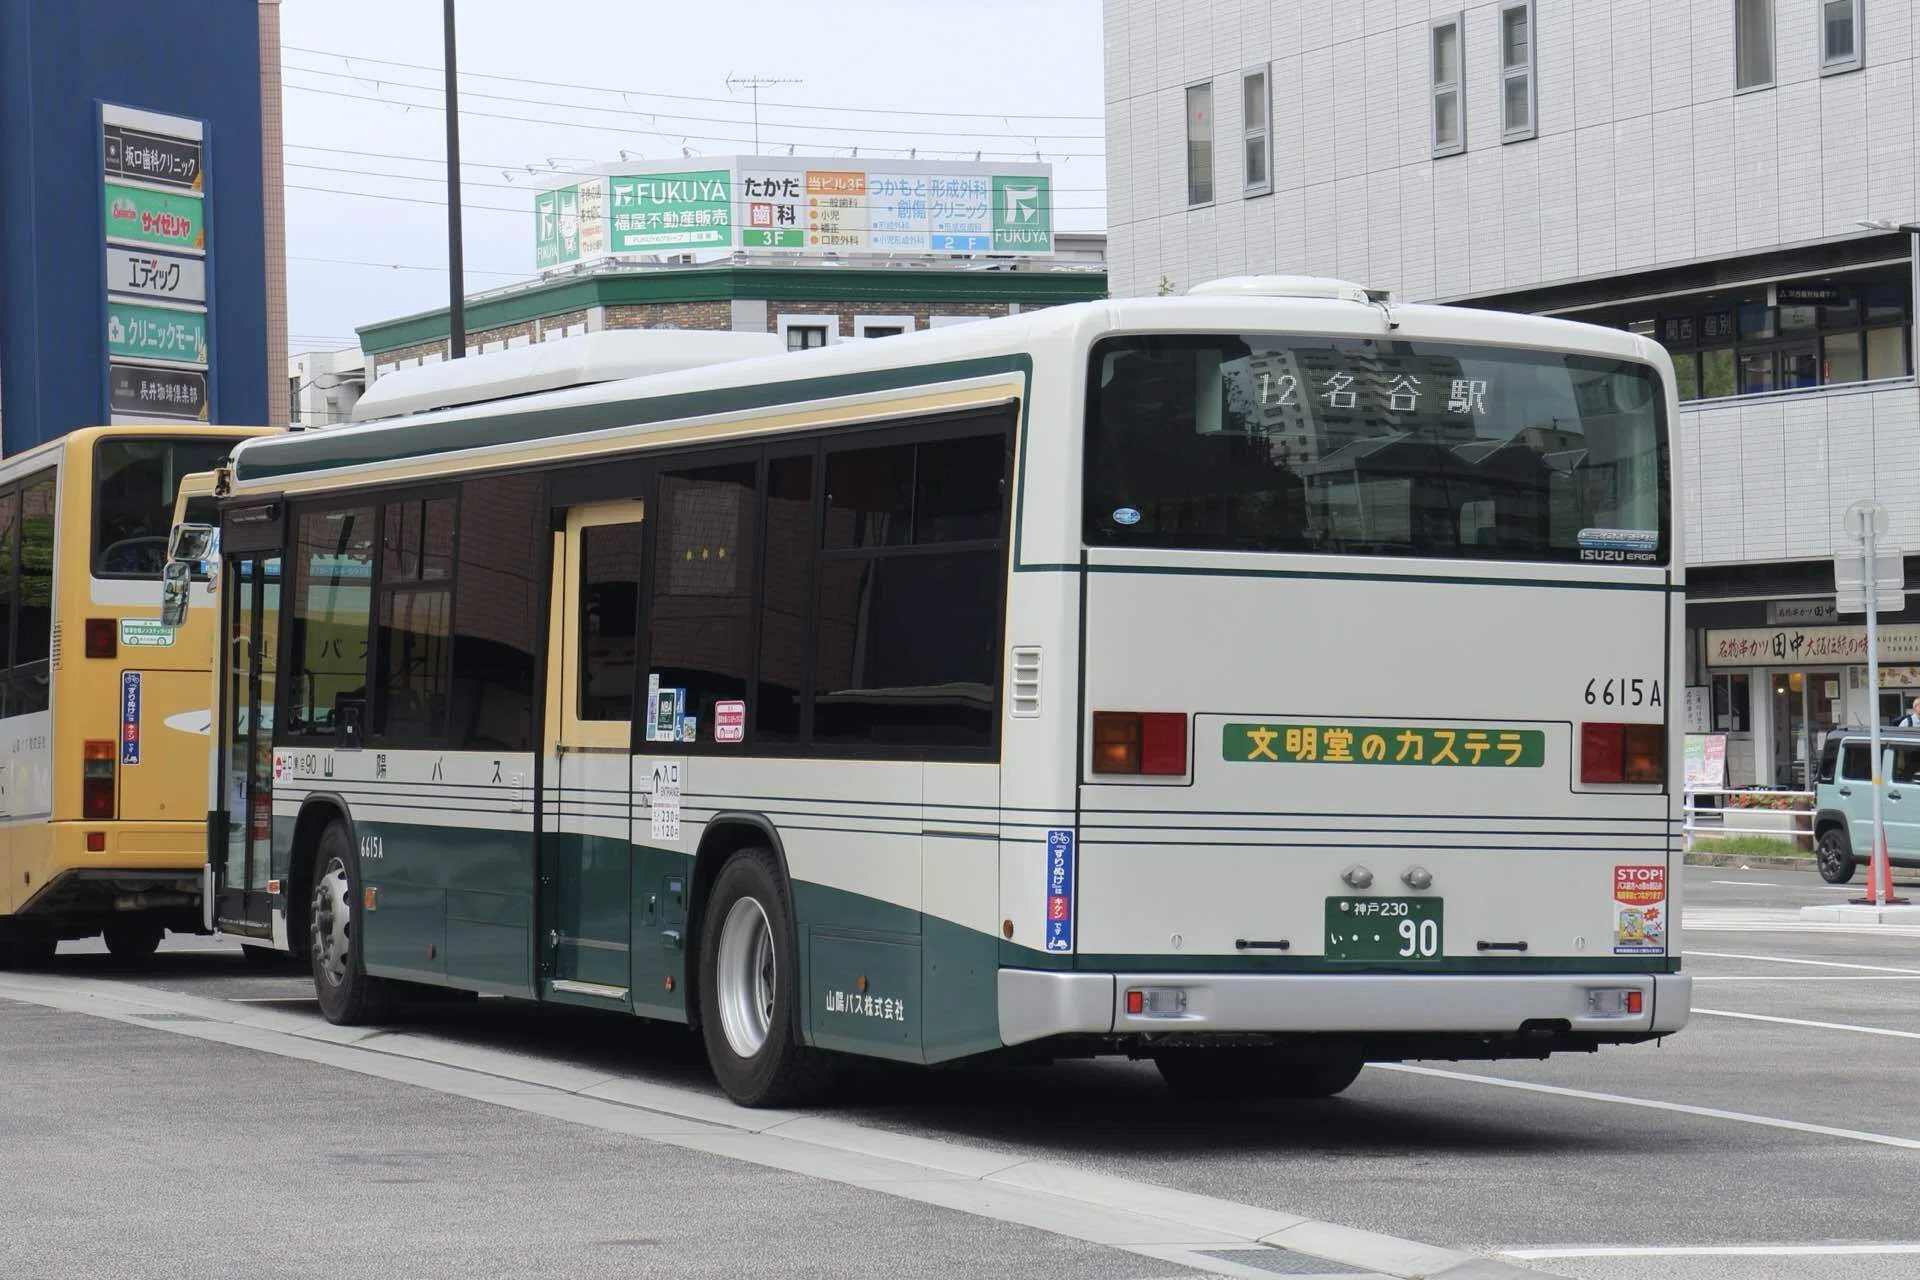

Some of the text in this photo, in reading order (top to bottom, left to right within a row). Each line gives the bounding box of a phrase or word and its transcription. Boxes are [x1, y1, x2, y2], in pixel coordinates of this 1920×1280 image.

[125, 145, 195, 177] 坂口歯科クリニック
[637, 179, 727, 206] FUKUYA
[745, 177, 799, 198] たかだ
[808, 176, 864, 192] 当ビル3F
[141, 211, 191, 240] サイゼリヤ
[614, 208, 728, 232] 福屋不動産販売
[752, 203, 796, 227] 歯科
[763, 231, 784, 245] 3F
[994, 228, 1048, 245] FUKUYA
[128, 257, 180, 291] エディック
[128, 318, 204, 352] クリニックモール
[1580, 549, 1656, 561] ISUZU ERGA
[1584, 677, 1661, 707] 6615A
[1246, 727, 1523, 765] 文明堂のカステラ
[662, 765, 678, 783] 入口
[360, 836, 383, 858] 6615A
[1617, 868, 1664, 881] STOP!
[1353, 902, 1409, 917] 神戸230
[826, 990, 904, 1022] 山陽バス株式会社
